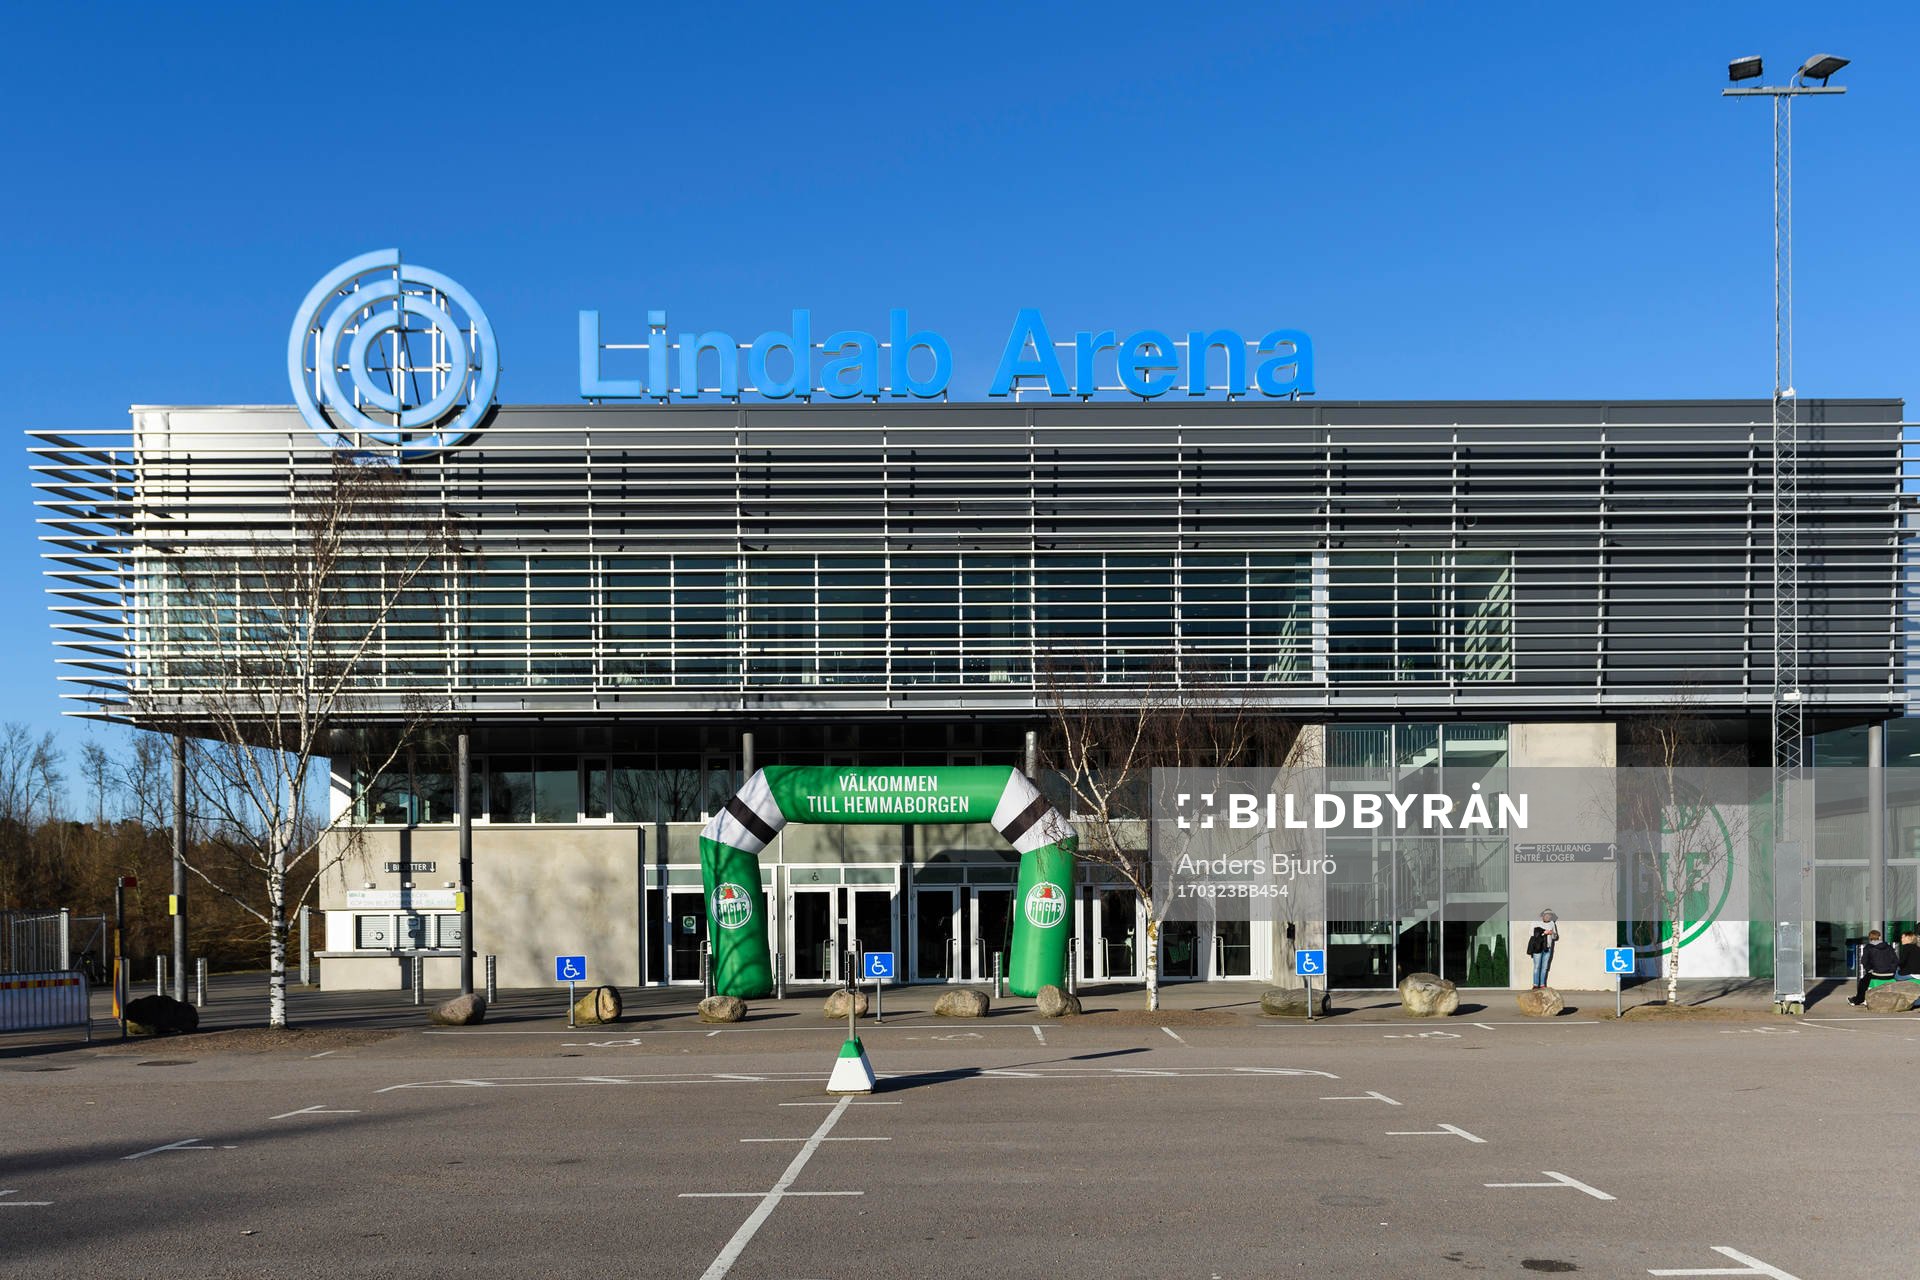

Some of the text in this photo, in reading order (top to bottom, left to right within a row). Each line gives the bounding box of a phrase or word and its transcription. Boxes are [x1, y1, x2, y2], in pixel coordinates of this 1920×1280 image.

[579, 308, 1316, 399] Lindab Arena
[839, 773, 938, 793] VÄLKOMMEN
[807, 796, 969, 814] TILL HEMMABORGEN
[1536, 844, 1592, 852] RESTAURANG
[1515, 852, 1575, 862] ENTRÉ, LOGER
[392, 863, 427, 871] BITTER
